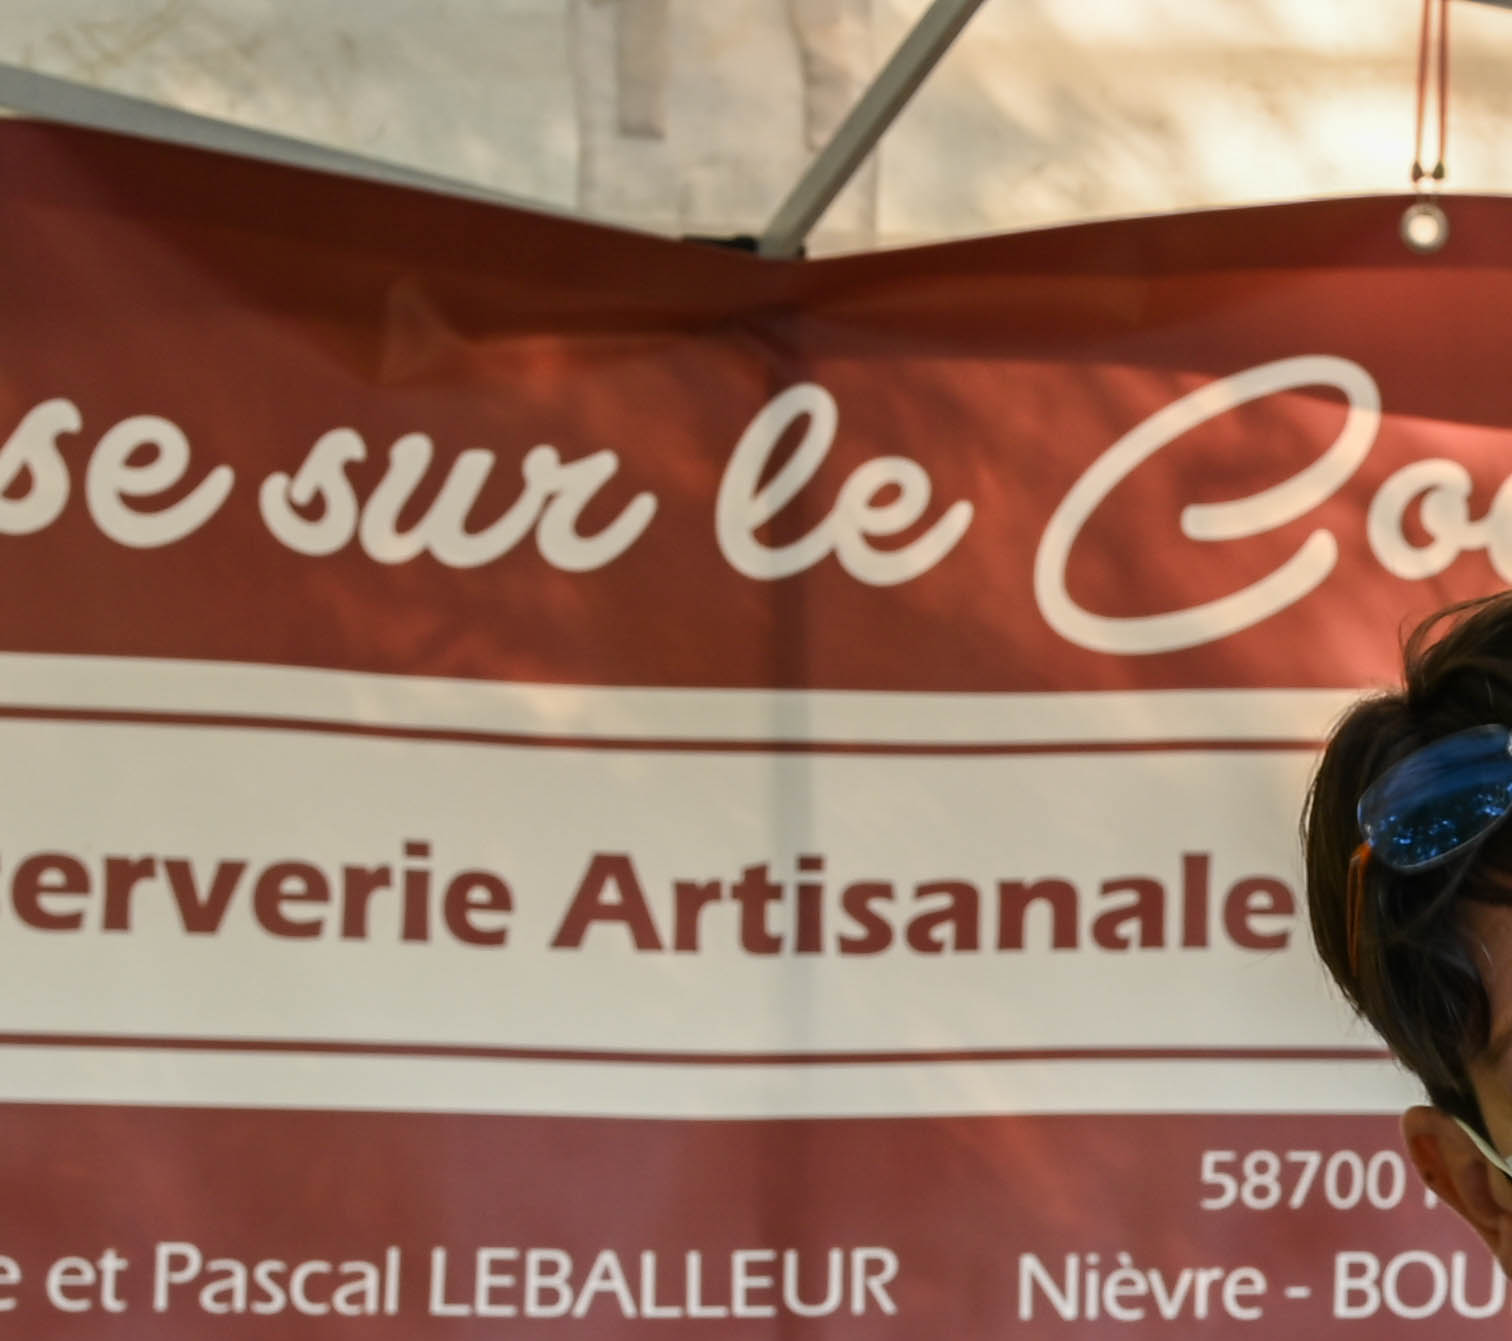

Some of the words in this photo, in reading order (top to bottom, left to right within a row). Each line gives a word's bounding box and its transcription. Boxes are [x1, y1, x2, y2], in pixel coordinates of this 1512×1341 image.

[259, 428, 656, 571] sur
[715, 382, 973, 586] le
[550, 852, 1294, 955] Artisanale
[1199, 1150, 1406, 1210] 58700
[45, 1250, 127, 1313] et
[153, 1241, 400, 1316] Pascal
[430, 1248, 898, 1317] LEBALLEUR
[1018, 1250, 1267, 1322] Nièvre
